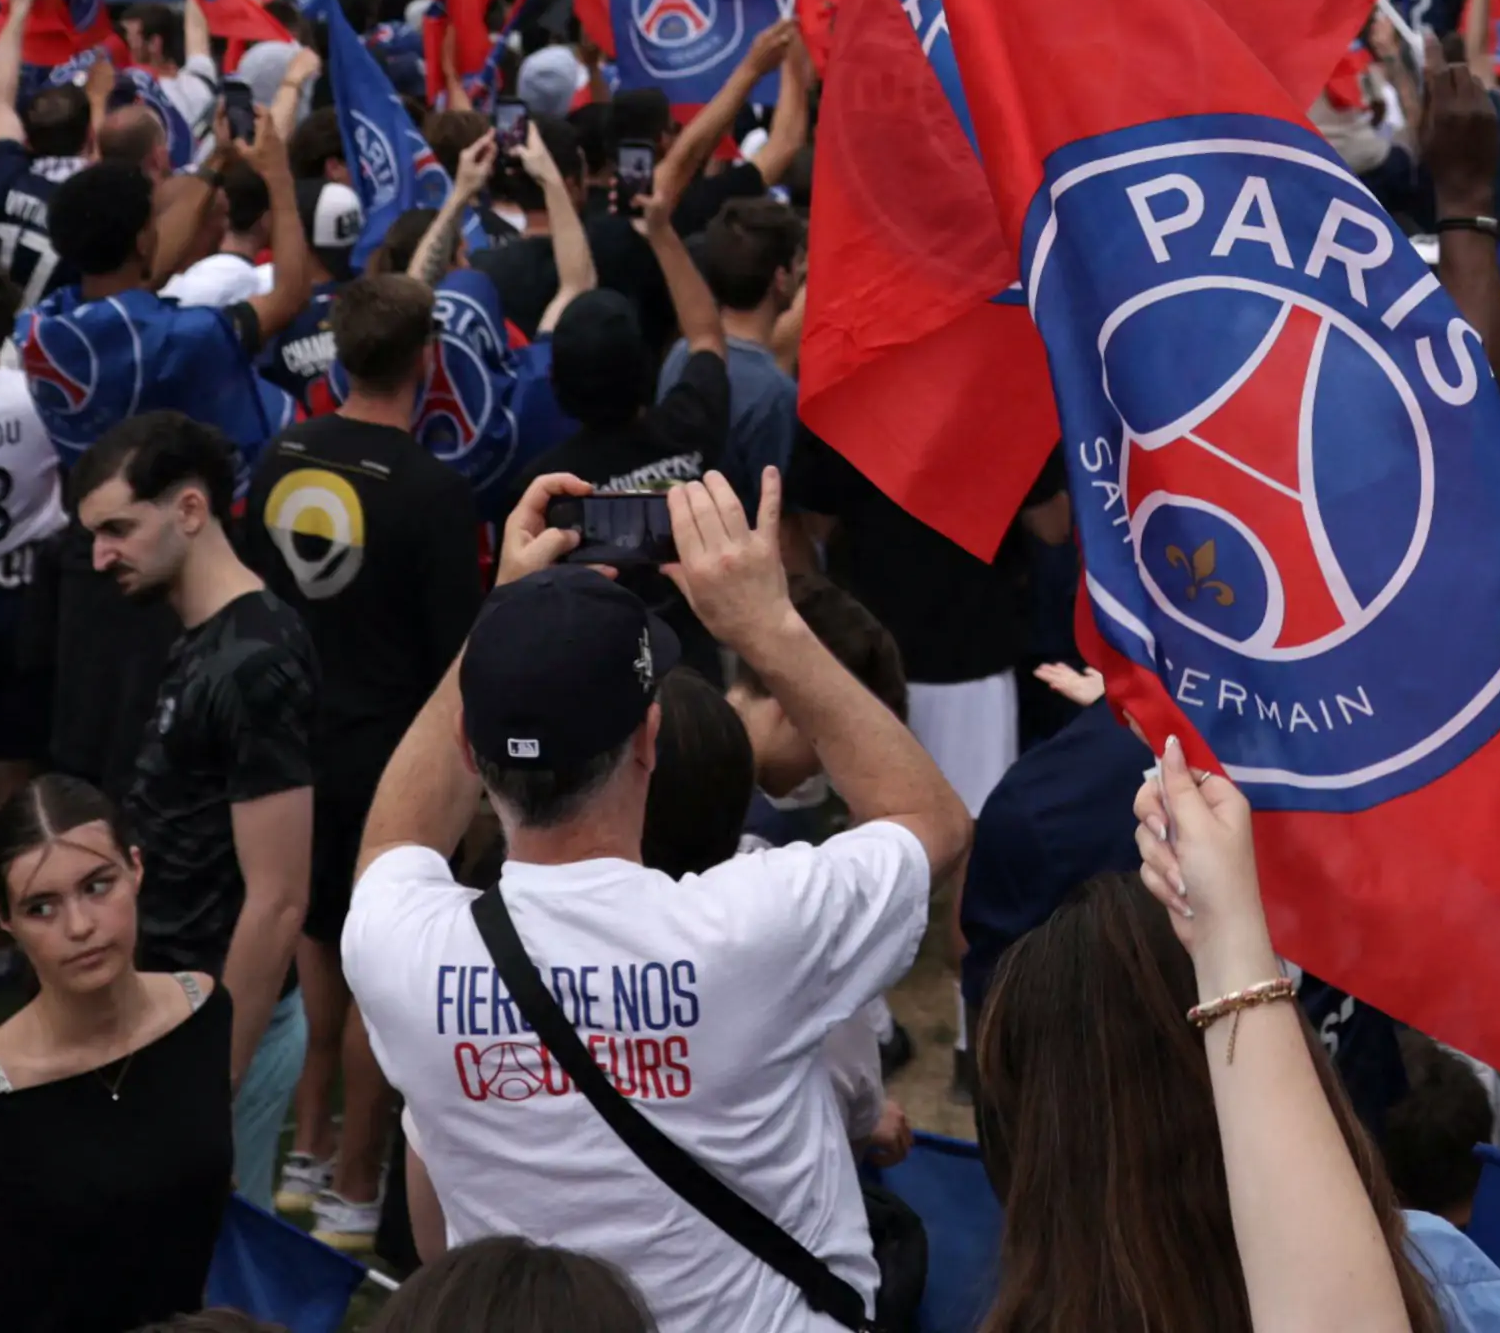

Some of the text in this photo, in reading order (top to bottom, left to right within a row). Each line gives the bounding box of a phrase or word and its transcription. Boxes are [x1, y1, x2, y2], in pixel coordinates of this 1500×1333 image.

[1125, 173, 1482, 407] PARIS
[1165, 660, 1374, 733] ERMAIN
[436, 959, 700, 1035] FIER DE NOS
